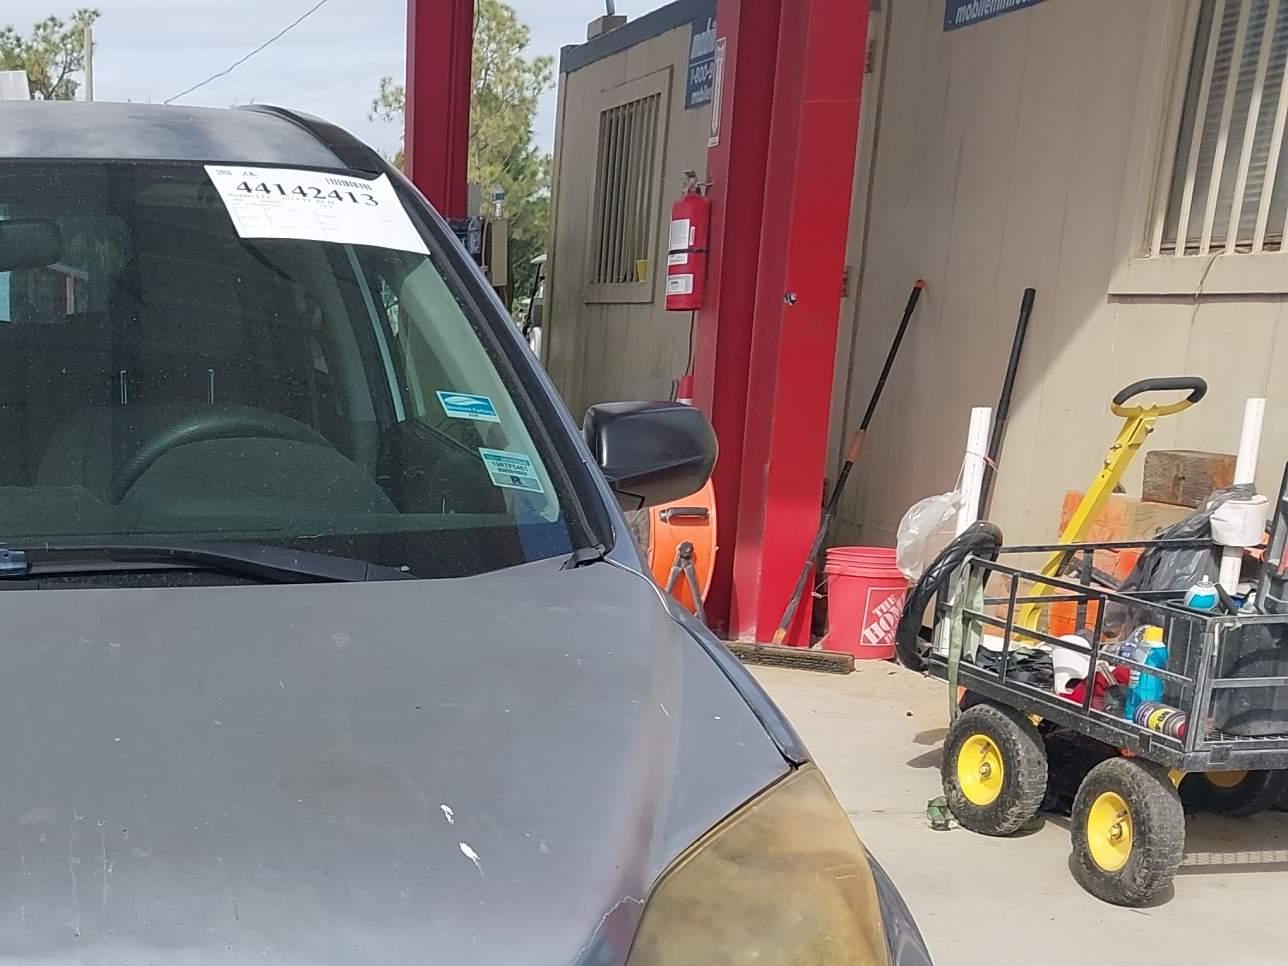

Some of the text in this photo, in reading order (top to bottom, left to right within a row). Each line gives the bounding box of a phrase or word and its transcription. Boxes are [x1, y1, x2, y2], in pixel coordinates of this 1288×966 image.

[237, 181, 379, 206] 44142413
[864, 590, 905, 644] HOM
[872, 594, 896, 618] THE
